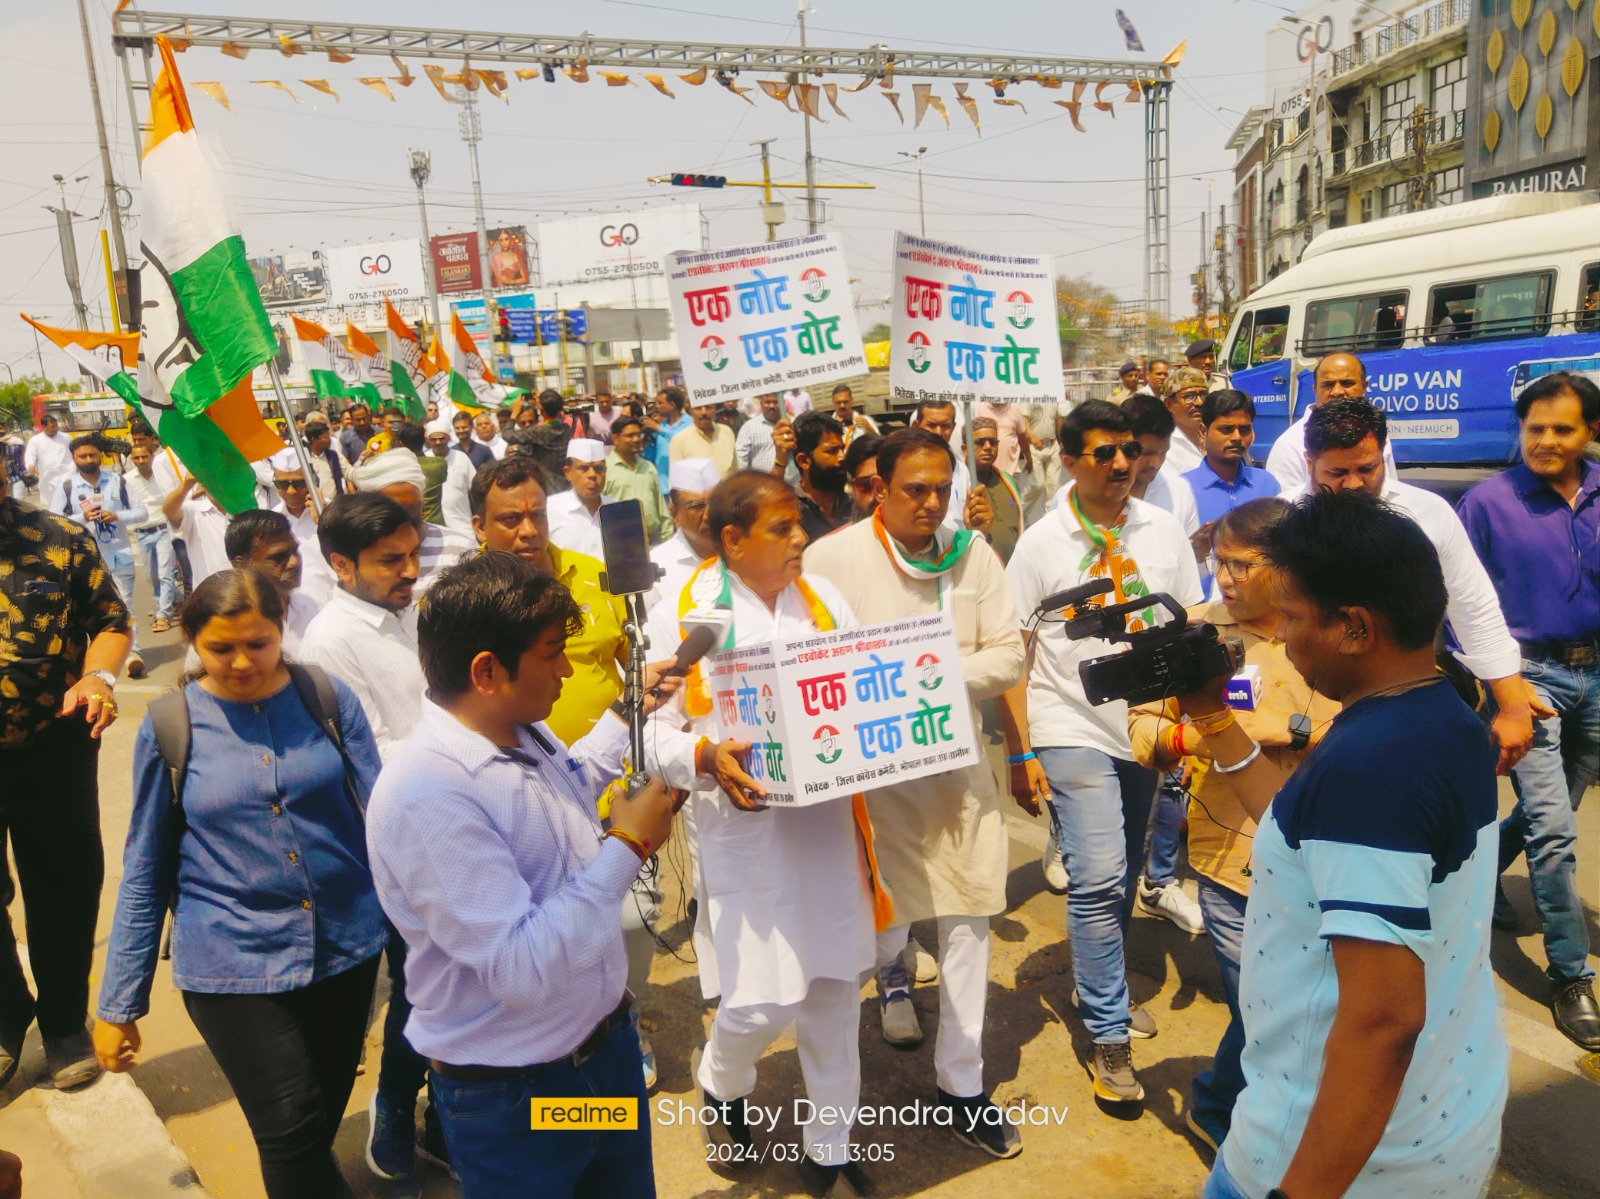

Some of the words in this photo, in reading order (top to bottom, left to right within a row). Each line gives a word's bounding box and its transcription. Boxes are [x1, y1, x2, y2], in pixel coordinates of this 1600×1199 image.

[600, 223, 639, 247] GO
[360, 254, 391, 277] GO
[684, 286, 731, 327] एक
[735, 268, 792, 316] नोट
[904, 276, 943, 321] एक
[948, 274, 996, 329] नोट
[738, 326, 789, 369] एक
[791, 310, 843, 356] वोट
[944, 341, 987, 383] एक
[991, 334, 1041, 385] वोट
[1369, 394, 1419, 413] OLVO
[1425, 392, 1459, 411] BUS
[1414, 369, 1462, 390] VAN
[1408, 424, 1453, 434] NEEMUCH
[717, 690, 737, 727] एक
[737, 675, 762, 726] नोट
[796, 672, 846, 716] एक
[852, 653, 907, 703] नोट
[854, 714, 903, 760] एक
[906, 698, 954, 746] वोट
[763, 729, 787, 782] वोट
[836, 775, 855, 787] जिला
